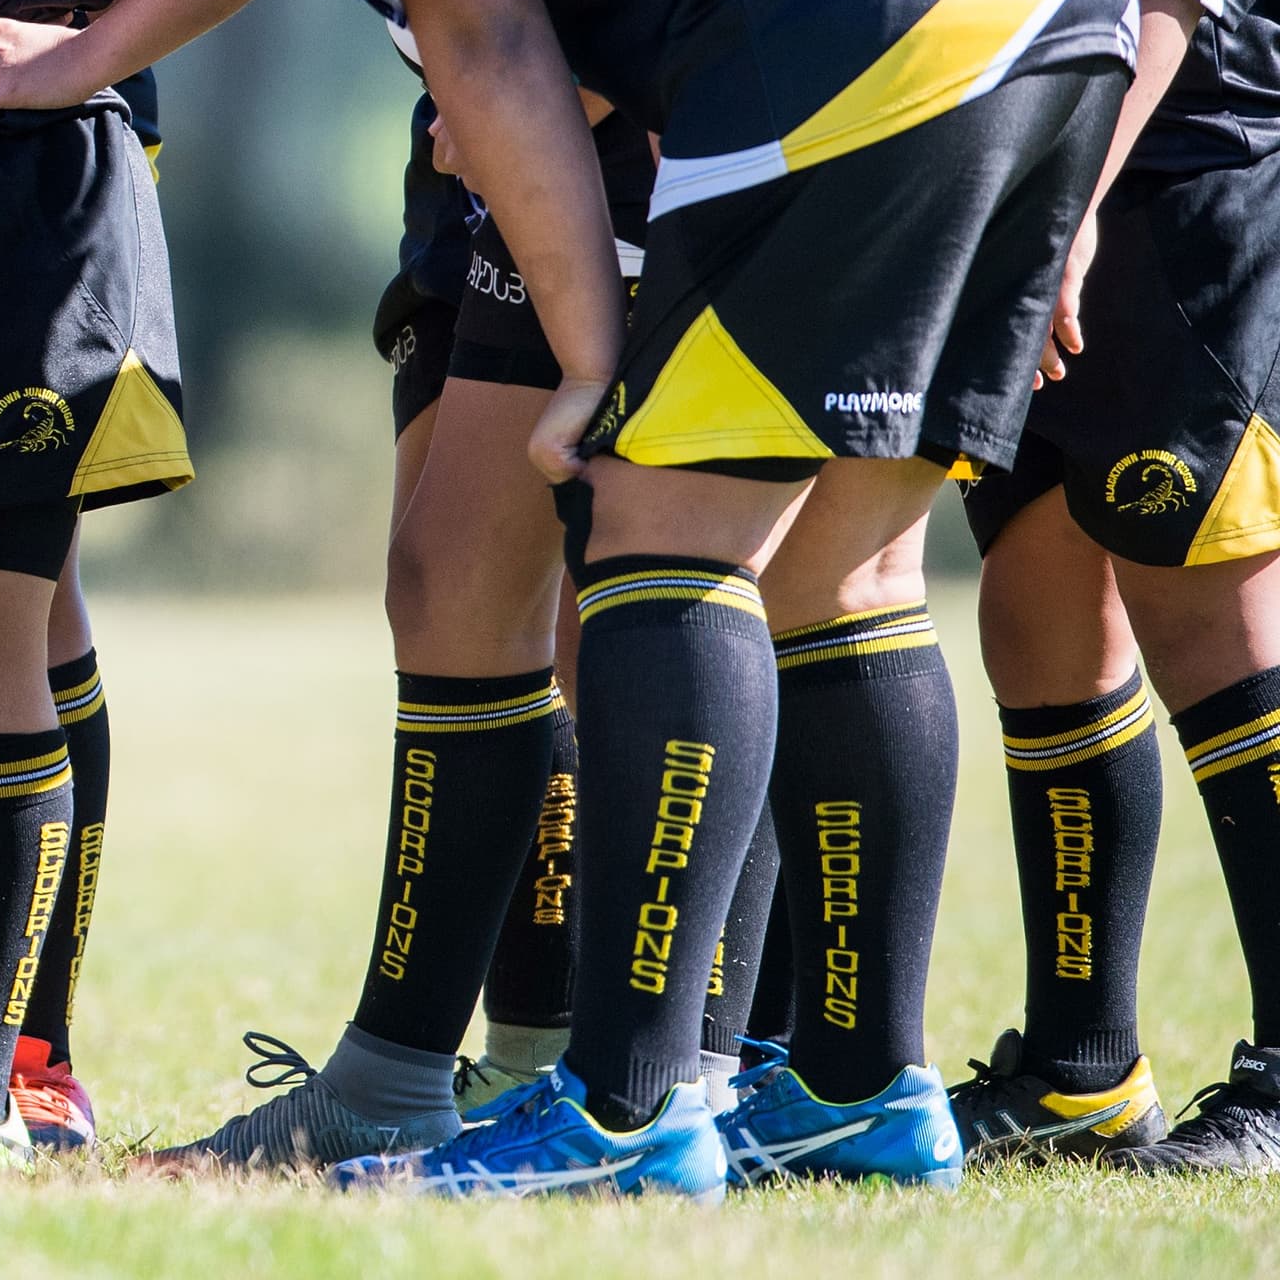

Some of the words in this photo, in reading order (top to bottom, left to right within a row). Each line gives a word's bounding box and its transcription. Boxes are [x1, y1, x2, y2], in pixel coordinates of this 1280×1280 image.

[23, 387, 59, 404] JUNIOR
[56, 399, 76, 432] RUGBY
[824, 391, 924, 414] PLAYMORE
[1105, 452, 1139, 502] BLACKTOWN
[1140, 449, 1177, 466] JUNIOR
[1175, 460, 1197, 492] RUGBY
[4, 821, 70, 1026] SCORPIONS
[380, 748, 438, 981] SCORPIONS
[629, 738, 716, 995] SCORPIONS
[815, 800, 862, 1030] SCORPIONS
[1046, 787, 1095, 980] SCORPIONS
